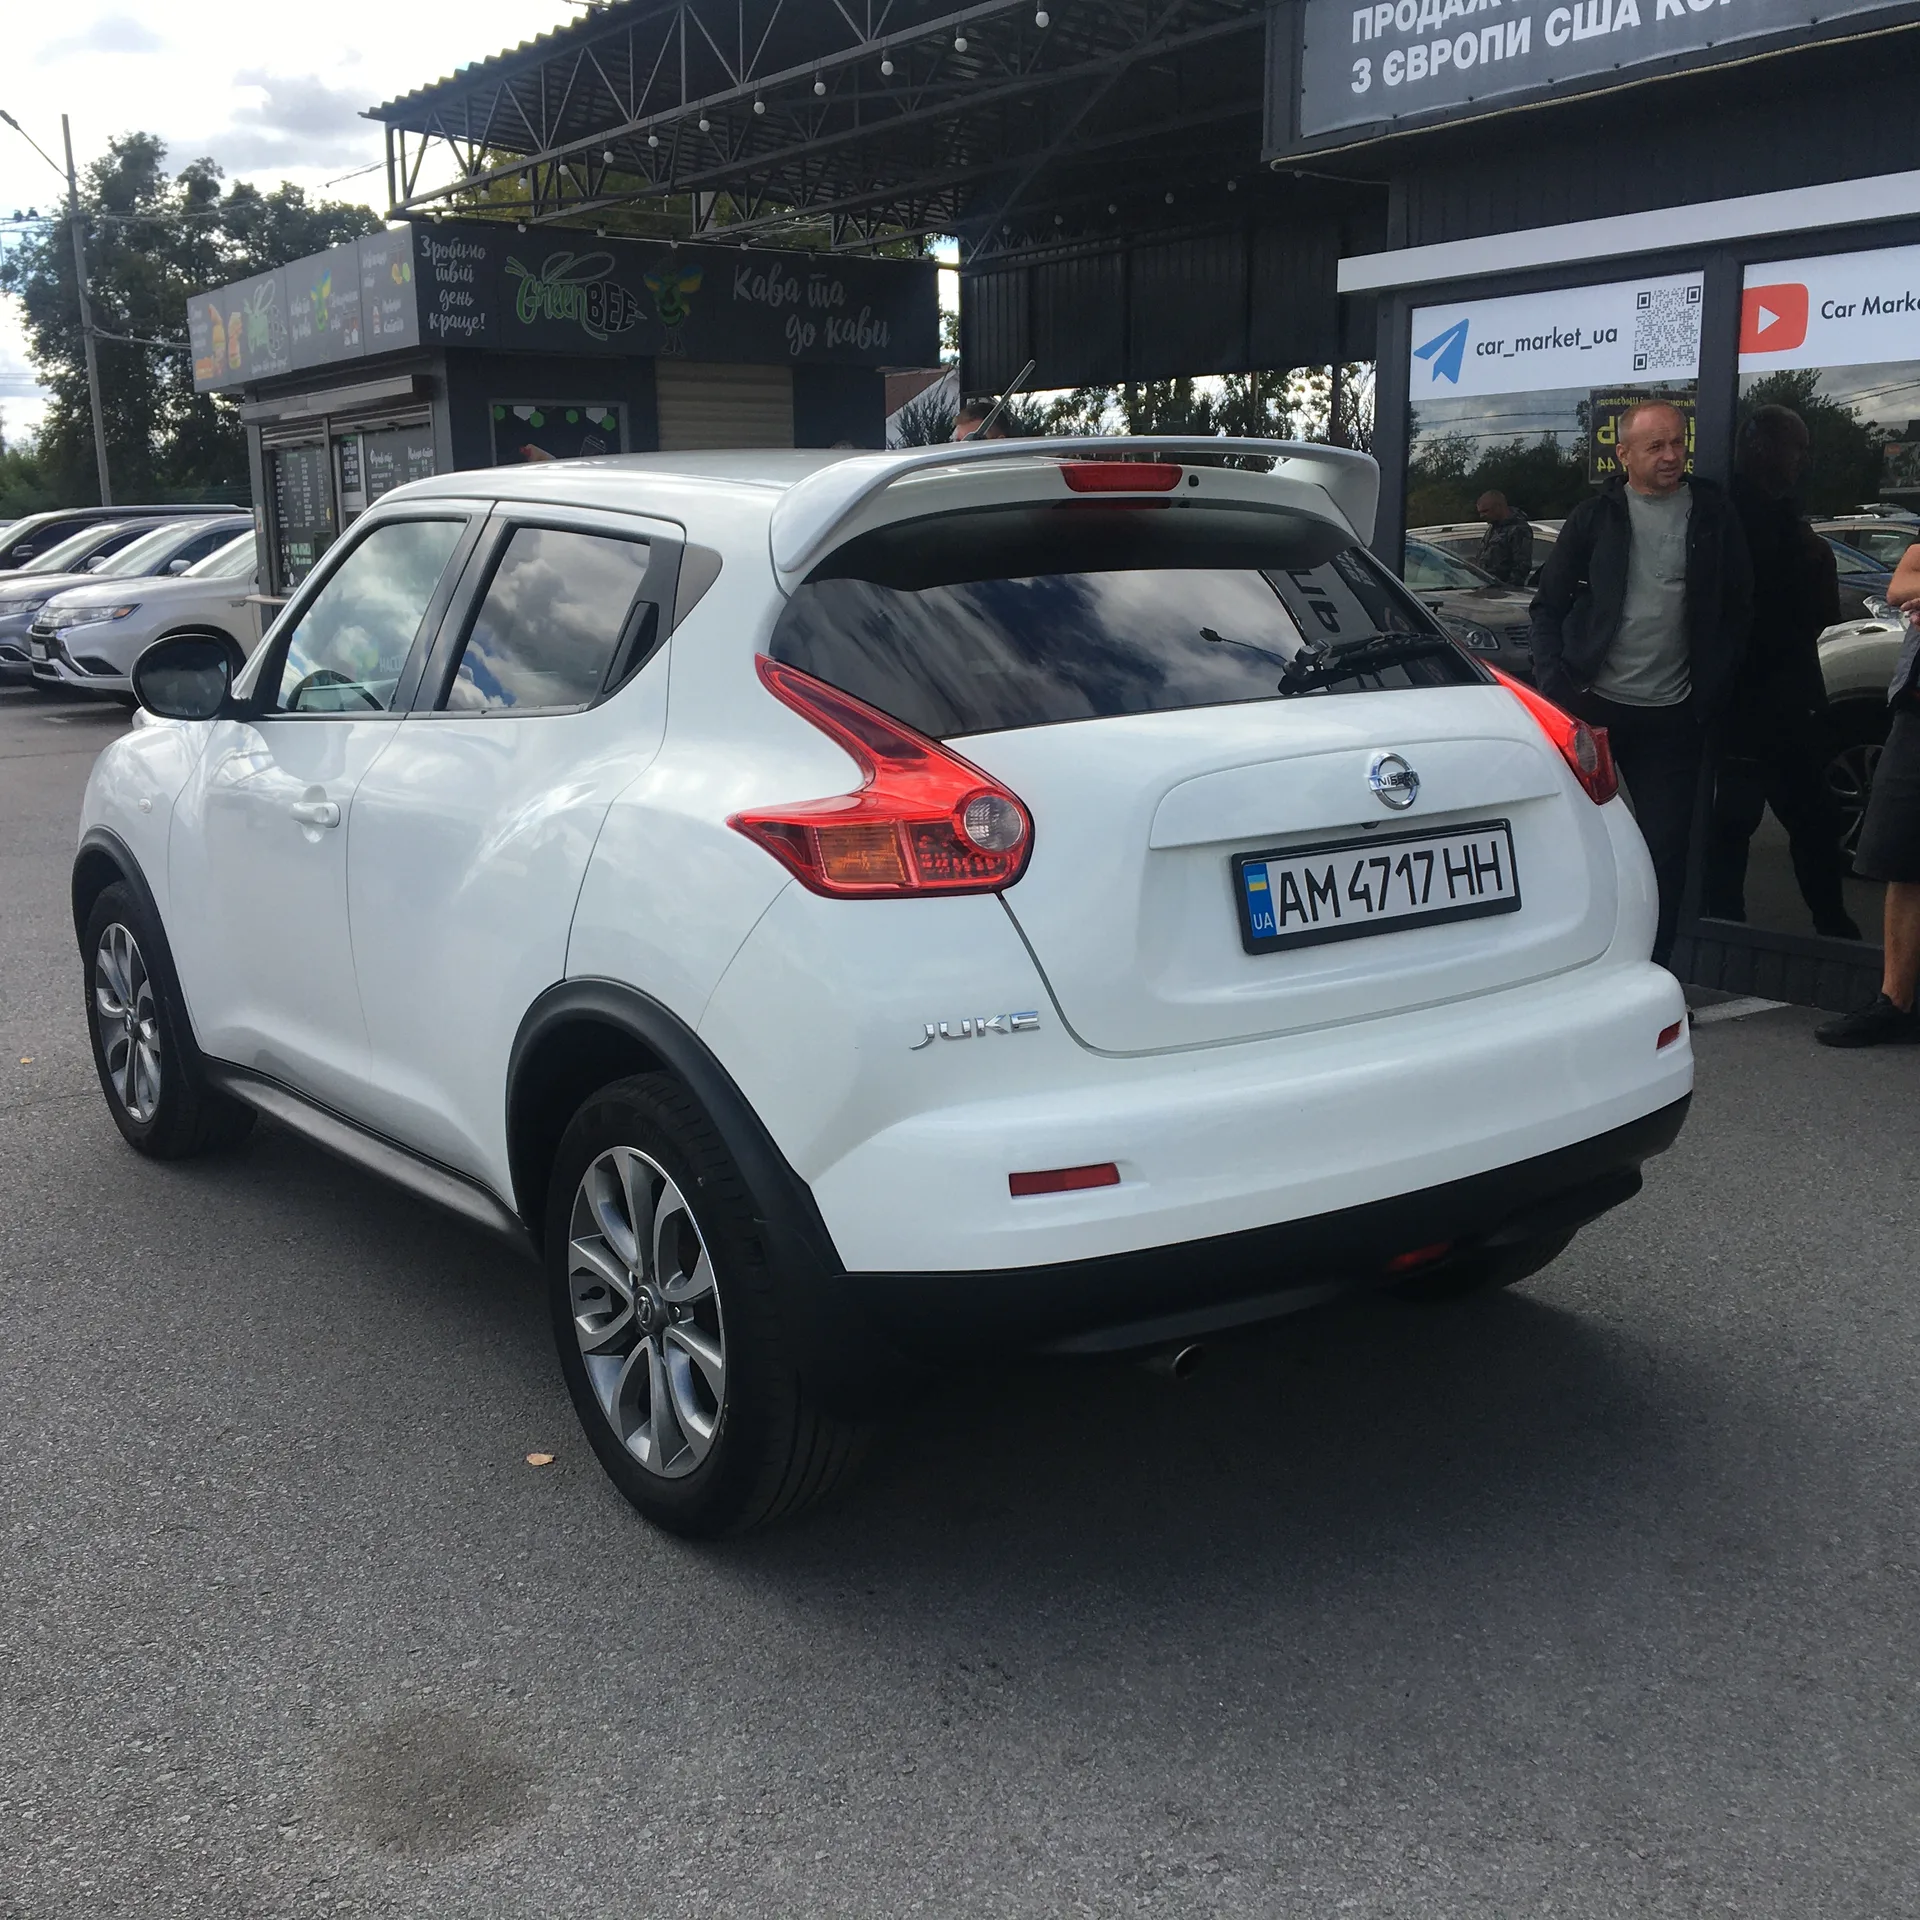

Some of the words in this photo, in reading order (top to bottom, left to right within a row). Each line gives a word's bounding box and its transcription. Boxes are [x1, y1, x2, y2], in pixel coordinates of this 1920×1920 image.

[1382, 16, 1532, 87] ЄВРОПИ
[1544, 0, 1641, 47] США
[420, 234, 486, 266] Зробимо
[435, 259, 475, 283] твій
[733, 261, 802, 307] Кава
[808, 272, 847, 308] та
[439, 289, 475, 312] день
[1821, 300, 1856, 319] Car
[428, 312, 486, 338] краще!
[785, 313, 817, 356] до
[824, 305, 891, 350] кави
[1476, 326, 1618, 358] car_market_ua
[1348, 849, 1434, 913] 4717
[1253, 913, 1274, 931] UA
[909, 1011, 1040, 1050] JUKE
